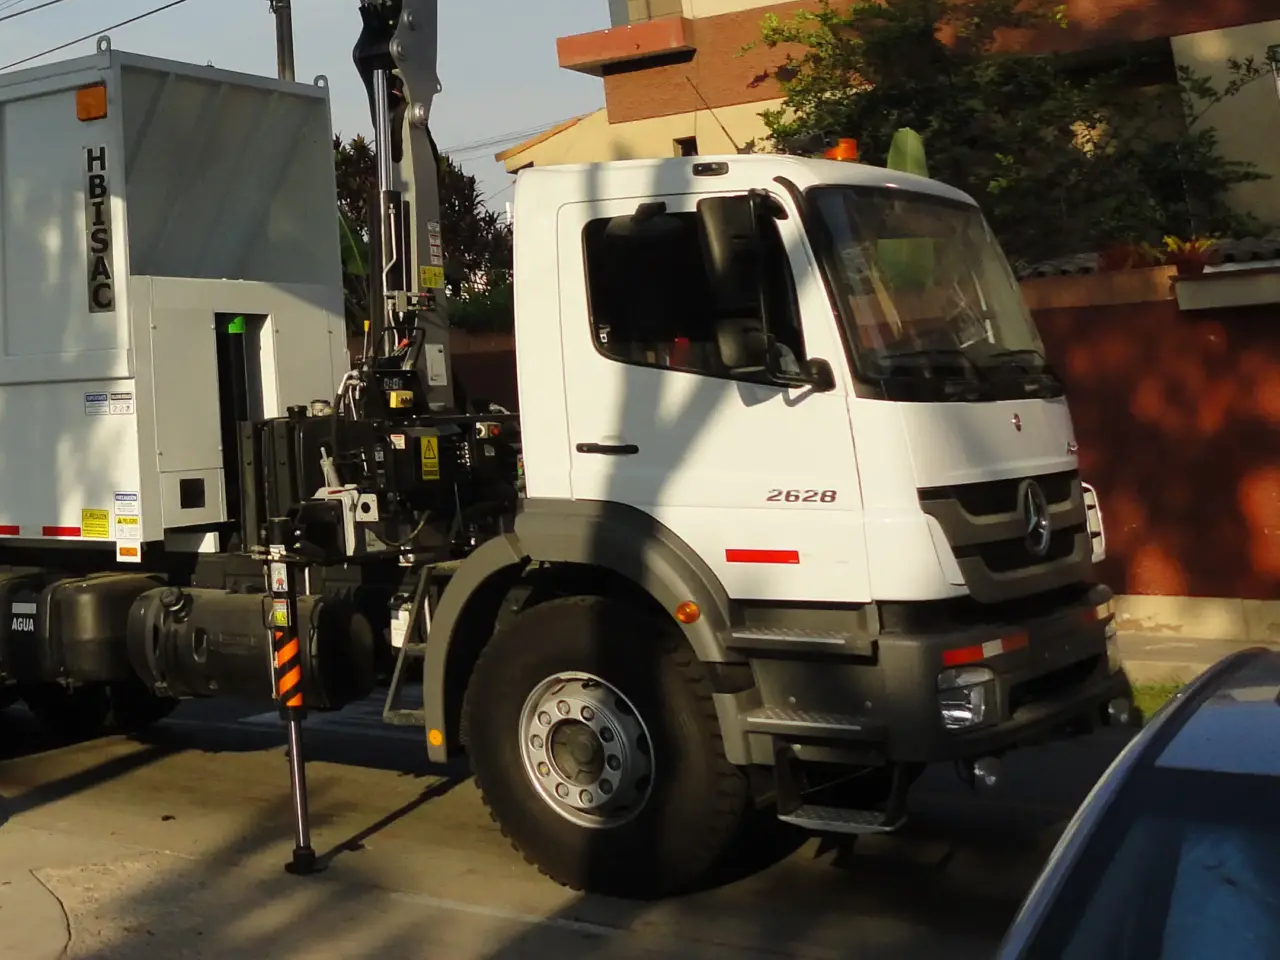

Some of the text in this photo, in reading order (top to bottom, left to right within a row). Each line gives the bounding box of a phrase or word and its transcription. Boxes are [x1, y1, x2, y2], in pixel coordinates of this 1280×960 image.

[86, 146, 112, 309] HBISAC
[766, 488, 838, 503] 2628
[11, 617, 35, 632] AGUA
